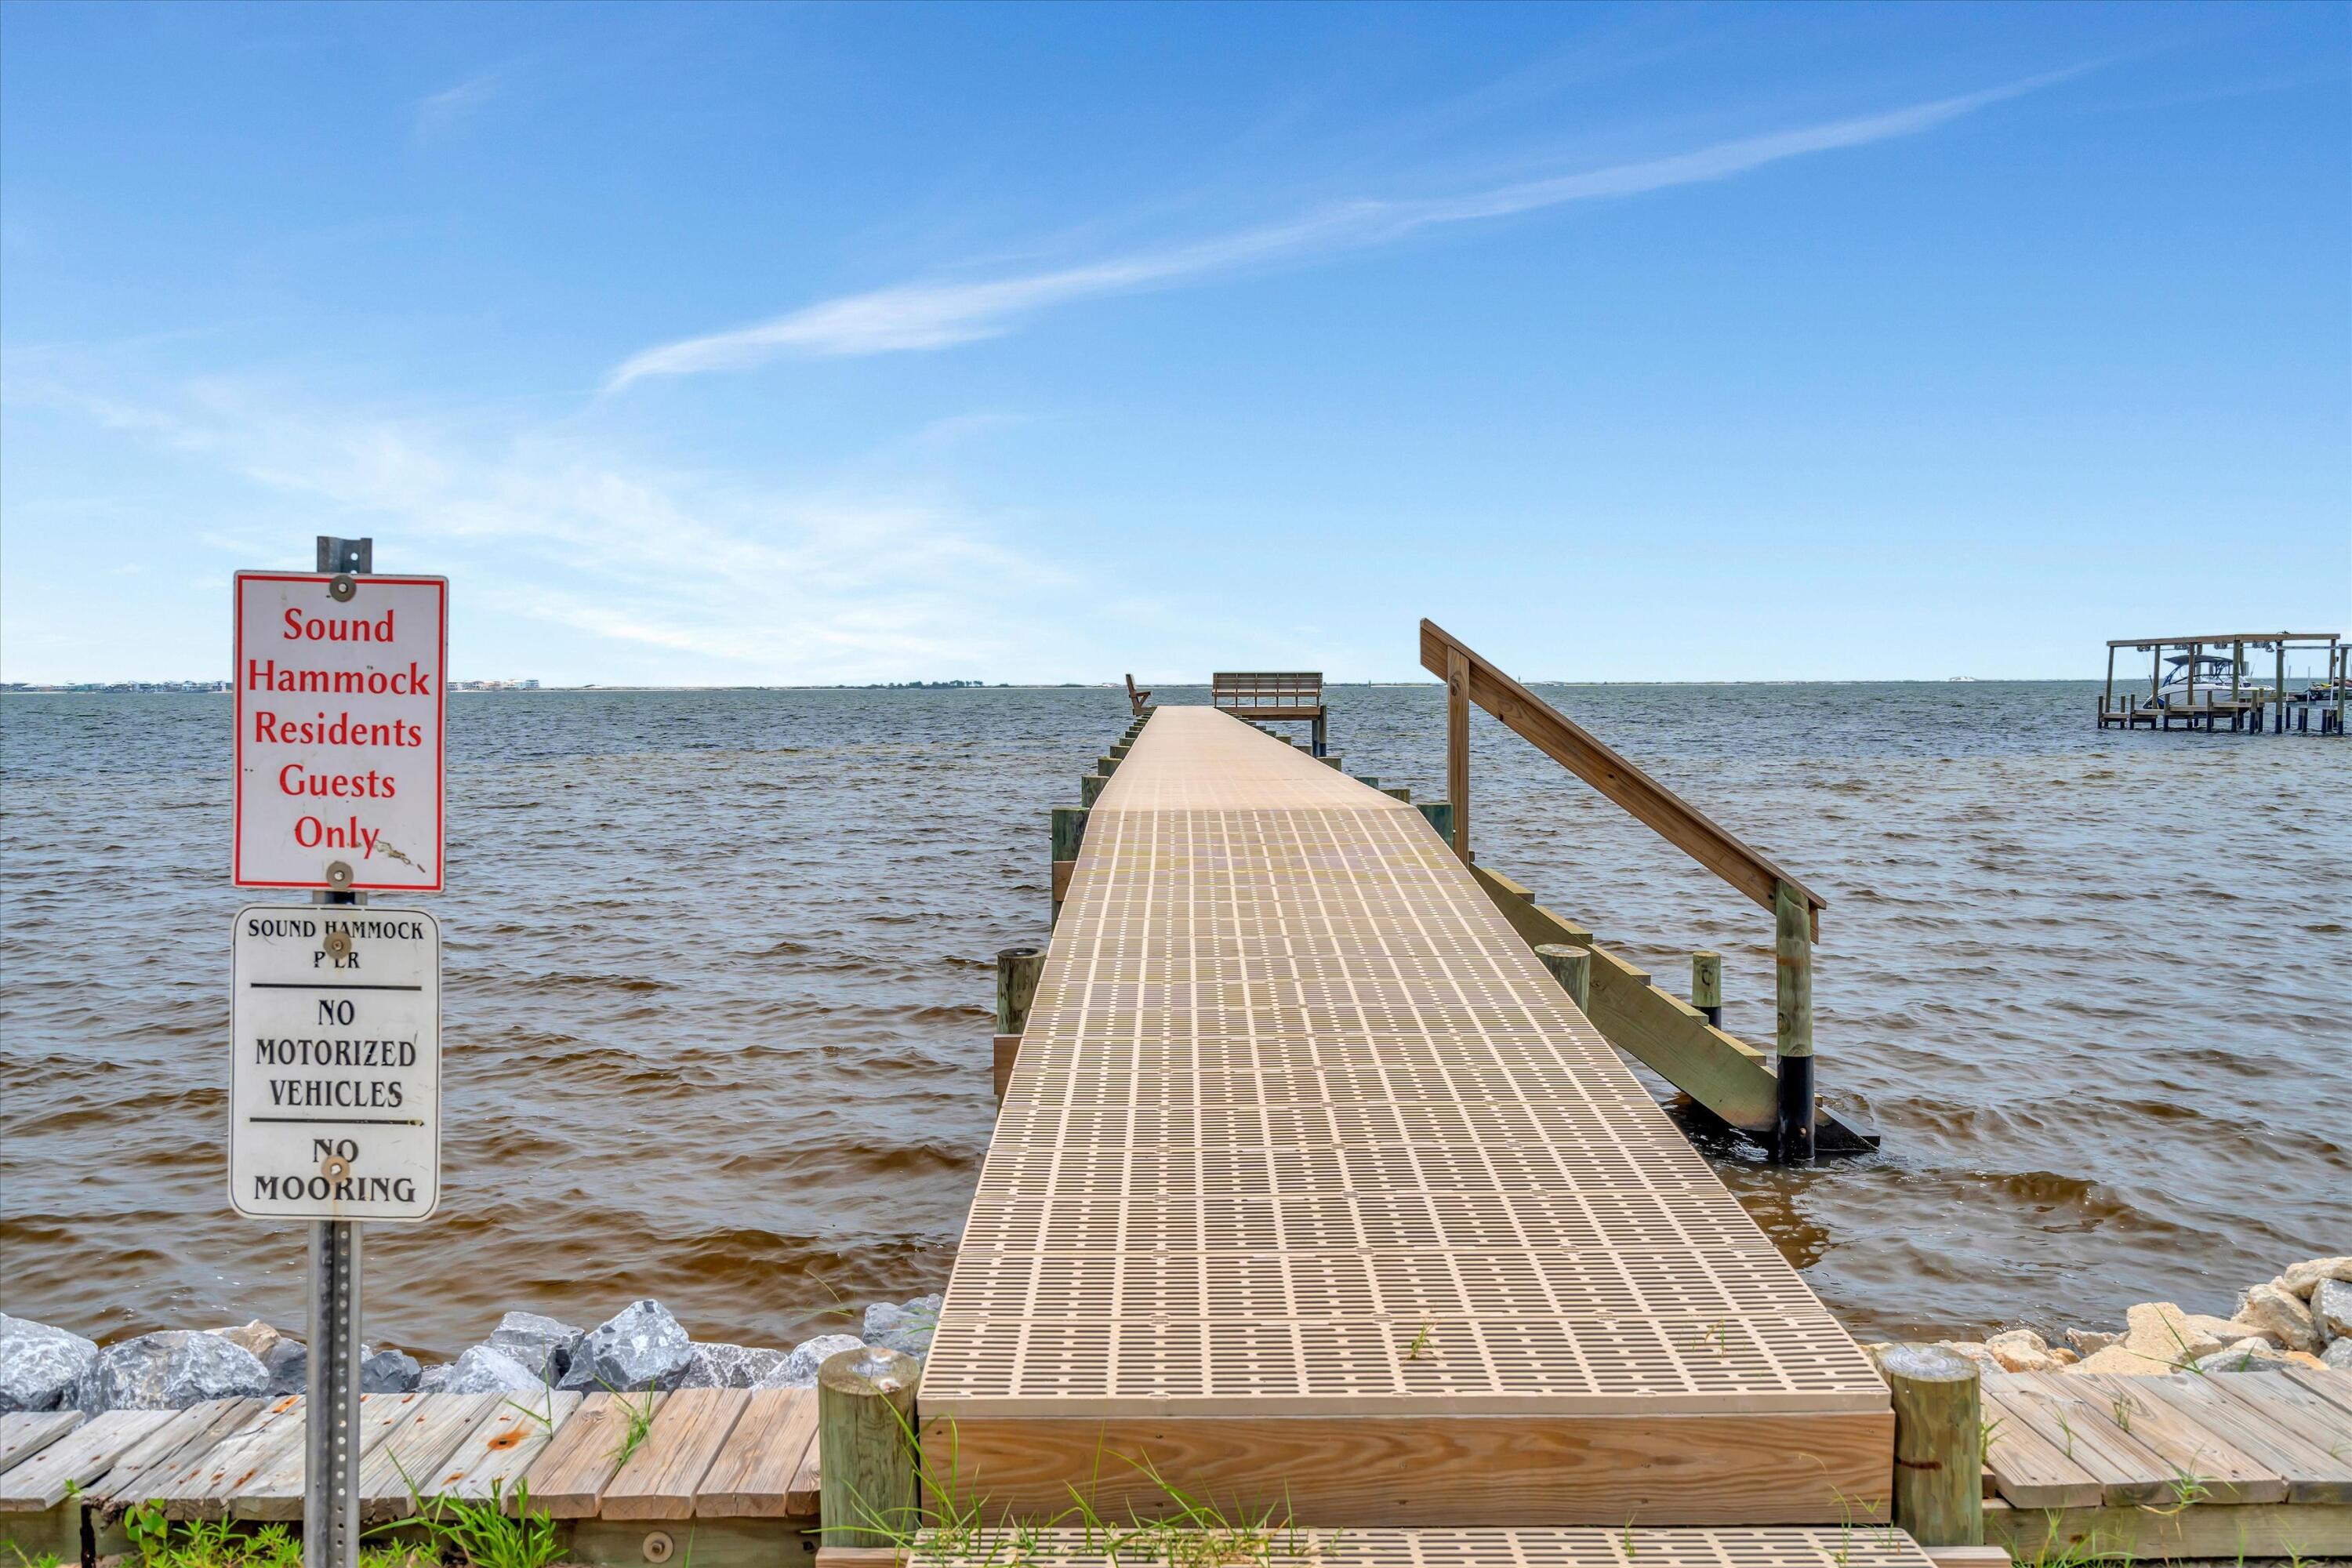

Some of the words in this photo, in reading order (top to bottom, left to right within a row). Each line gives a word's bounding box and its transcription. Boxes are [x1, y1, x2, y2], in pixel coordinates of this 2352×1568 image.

[283, 608, 394, 642] Sound
[248, 659, 430, 695] Hammock
[255, 711, 422, 747] Residents
[279, 764, 396, 798] Guests
[294, 815, 380, 859] Only
[249, 919, 316, 937] SOUND
[325, 920, 424, 940] HAMMOCK
[318, 1000, 354, 1025] NO
[256, 1039, 416, 1067] MOTORIZED
[270, 1080, 403, 1108] VEHICLES
[312, 1138, 358, 1163] NO
[254, 1175, 416, 1202] MOORING
